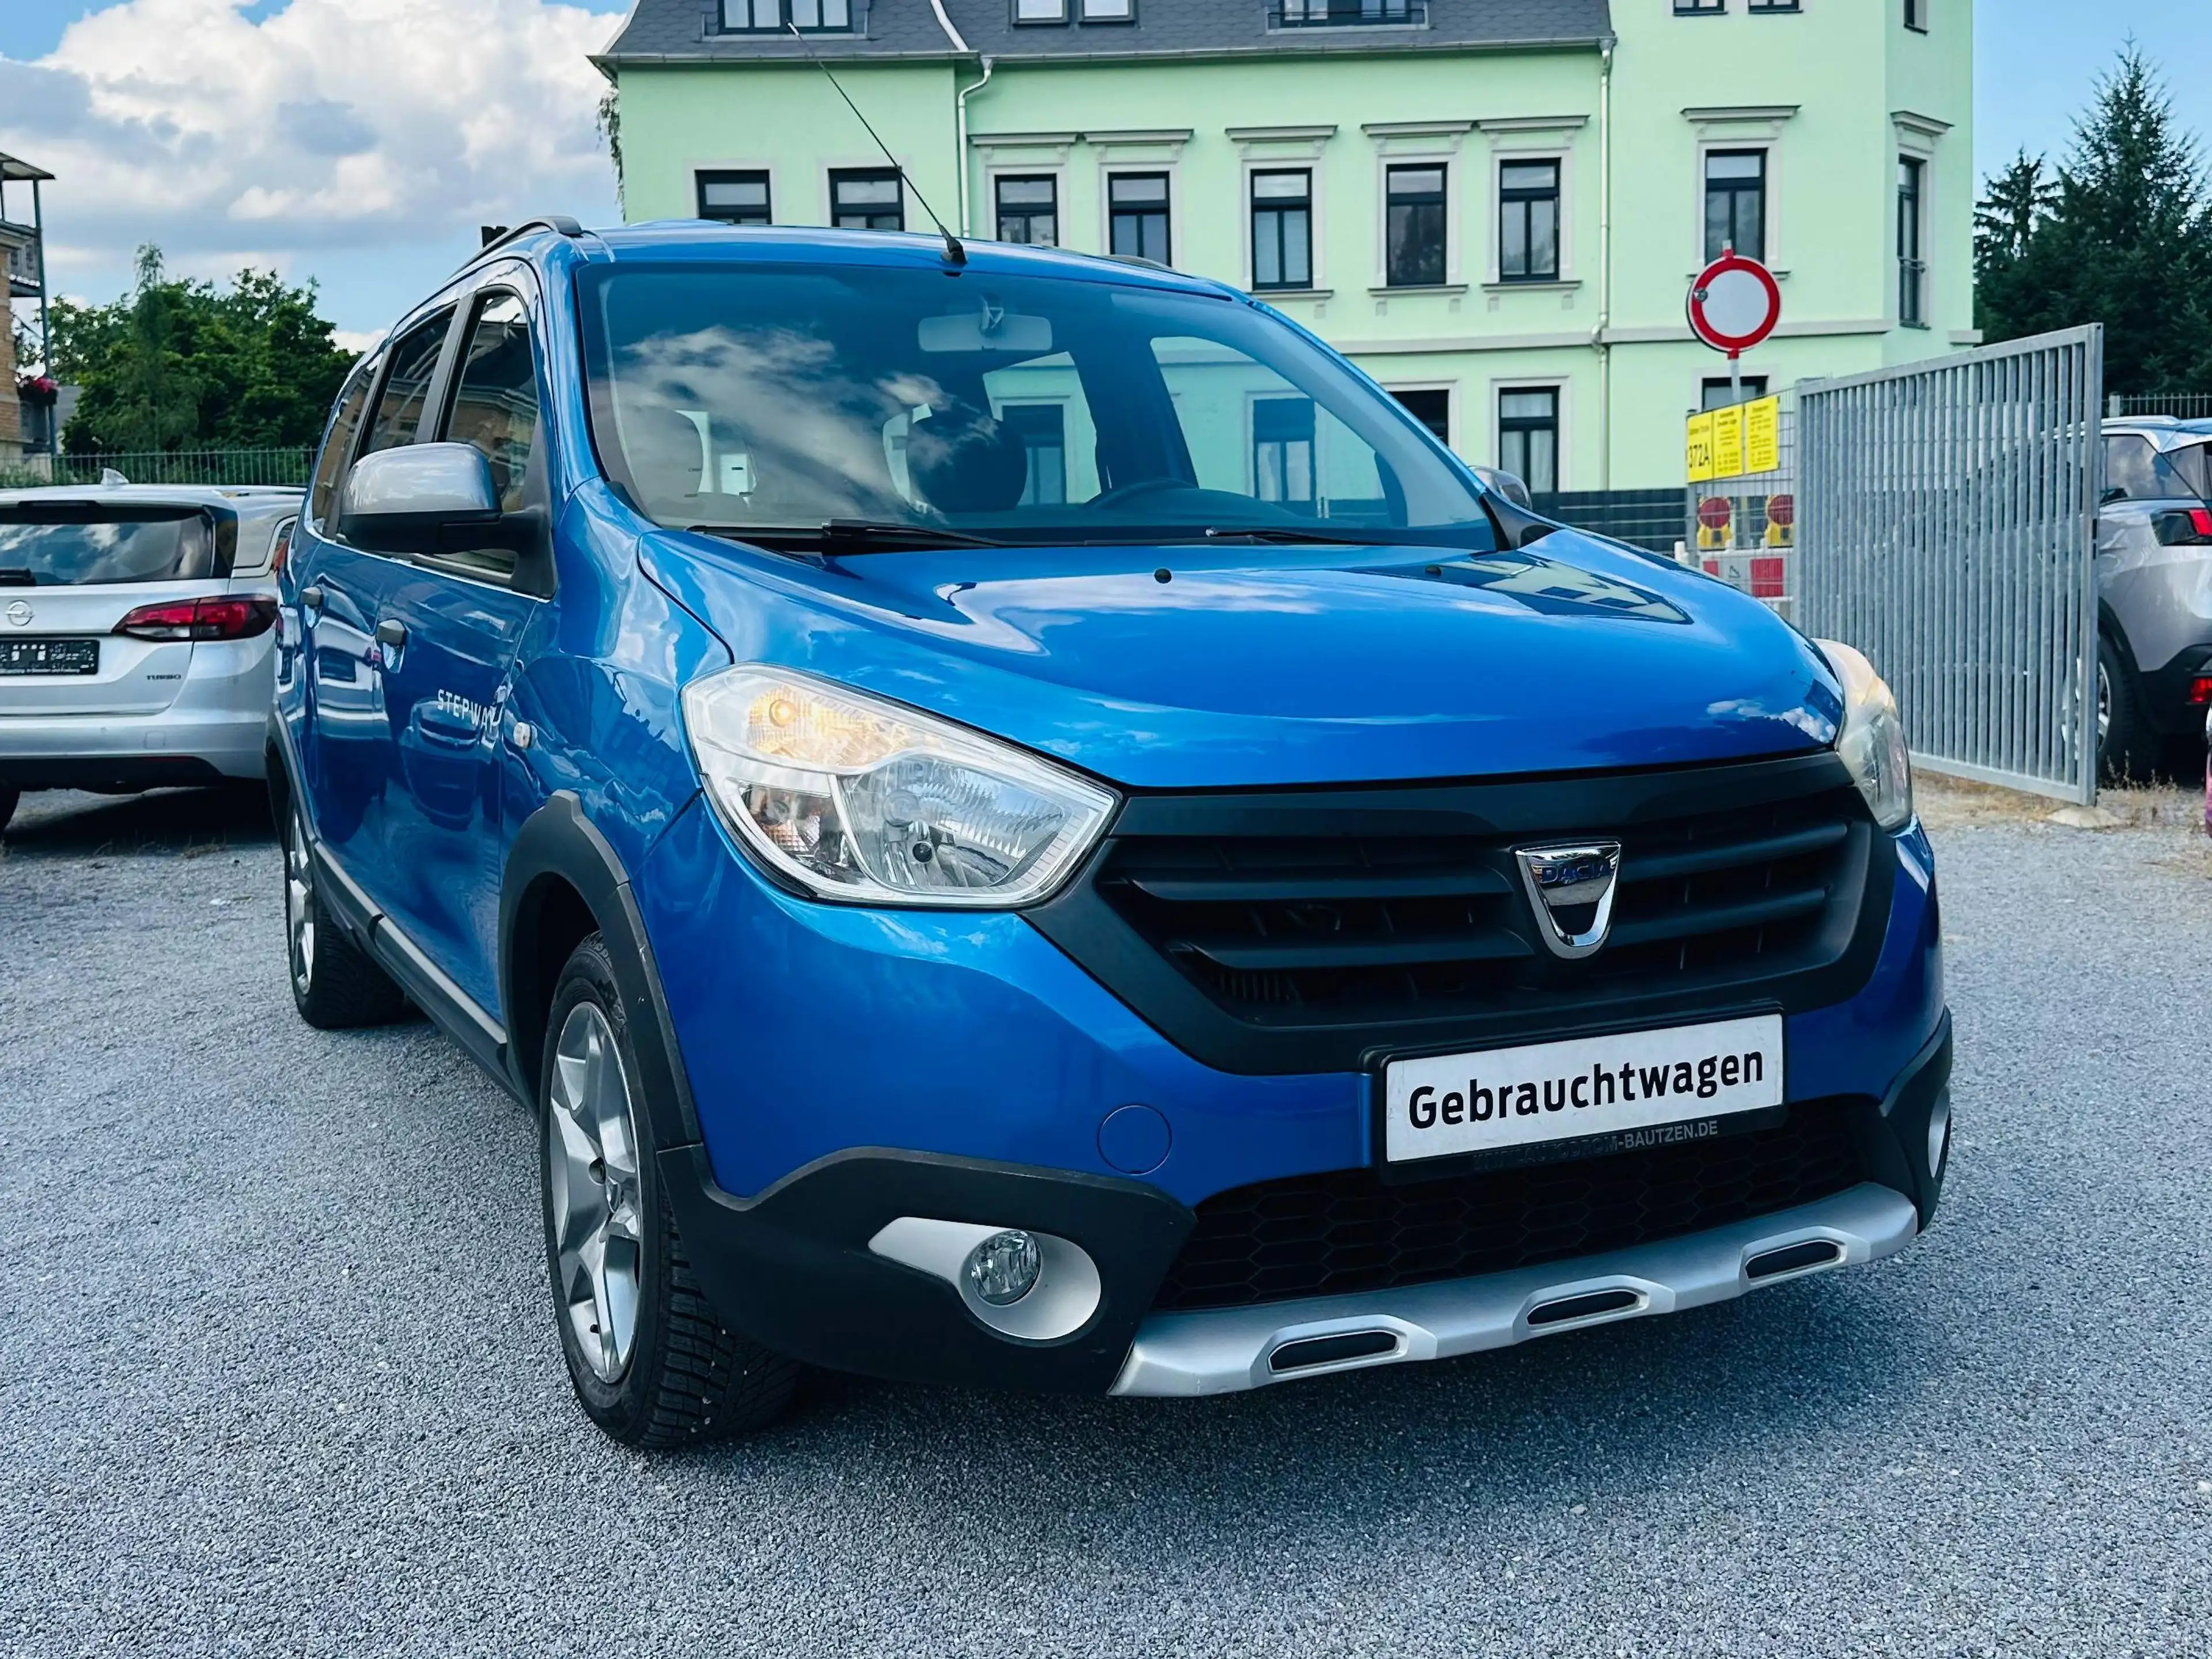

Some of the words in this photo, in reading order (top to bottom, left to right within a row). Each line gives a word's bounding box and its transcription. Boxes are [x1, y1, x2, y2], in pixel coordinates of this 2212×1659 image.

[1689, 442, 1710, 468] 372A
[437, 688, 497, 734] STEPWAY
[1409, 1051, 1763, 1129] Gebrauchtwagen
